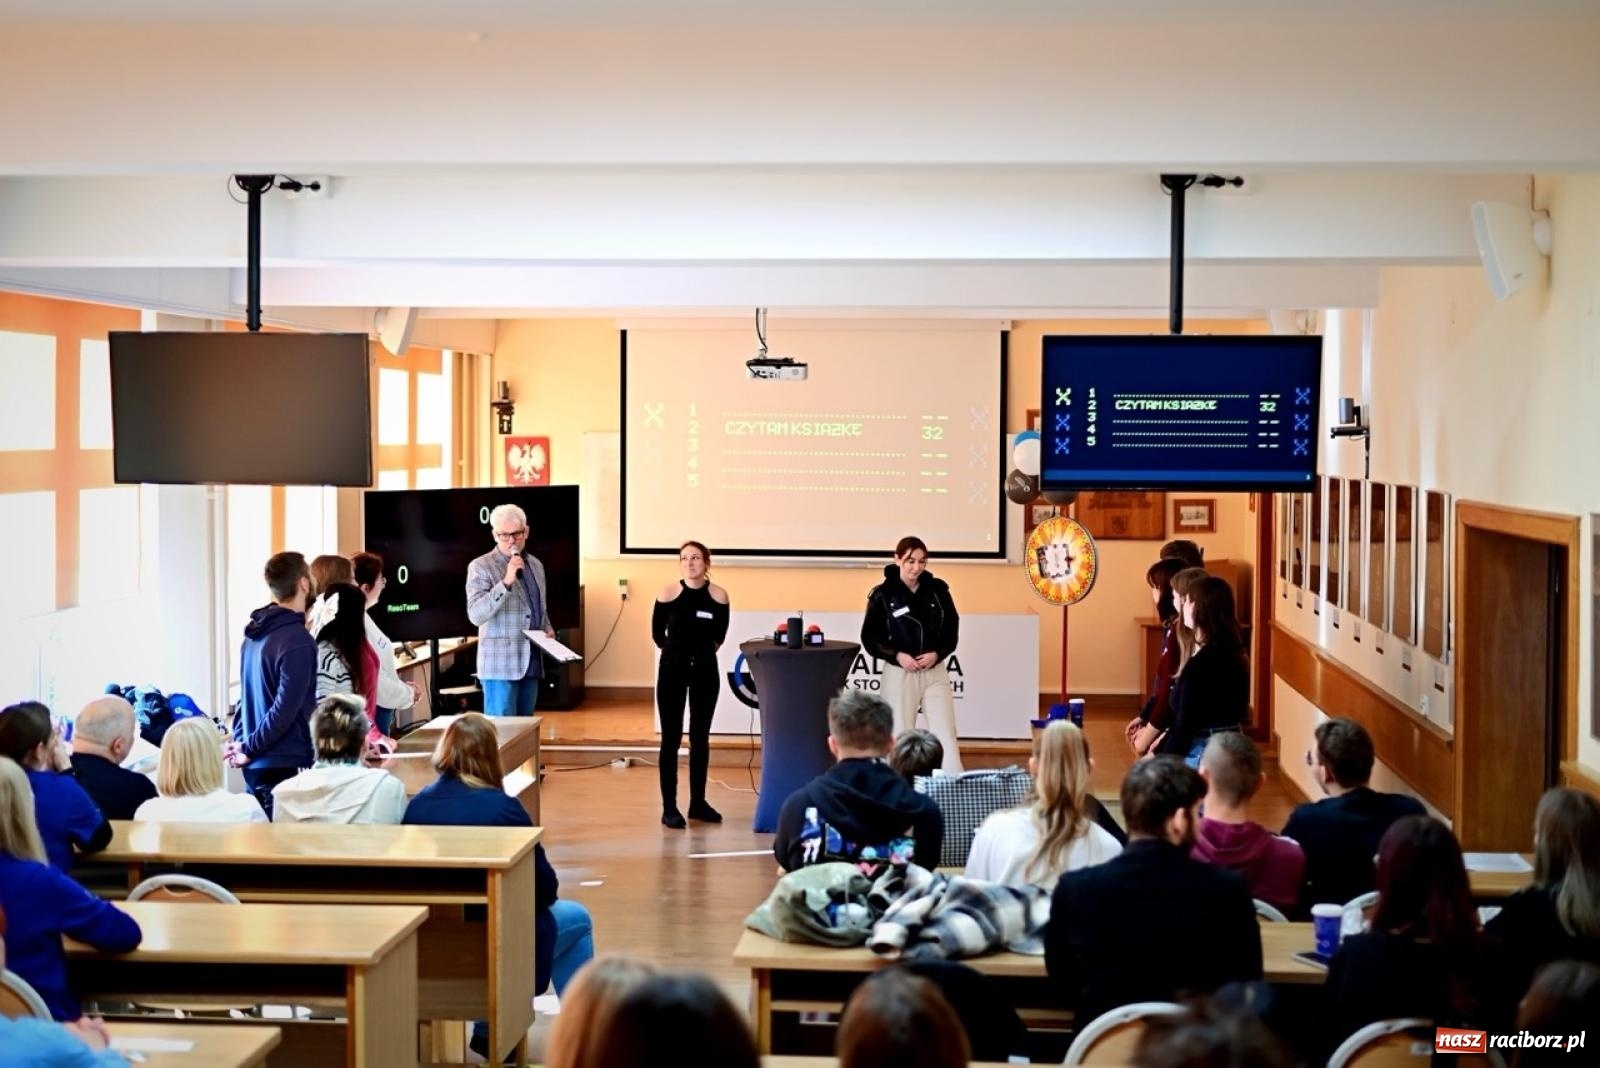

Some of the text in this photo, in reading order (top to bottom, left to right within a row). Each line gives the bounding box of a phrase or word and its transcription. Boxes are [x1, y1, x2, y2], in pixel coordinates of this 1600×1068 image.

[1089, 387, 1096, 398] 1
[1087, 399, 1097, 410] 2
[1115, 399, 1162, 411] CZYTAM
[1259, 401, 1277, 412] 32
[1087, 411, 1097, 422] 3
[686, 419, 699, 435] 2
[724, 420, 789, 436] CZYTAM
[921, 425, 944, 440] 32
[1086, 423, 1096, 434] 4
[686, 437, 699, 453] 3
[1086, 435, 1096, 446] 5
[686, 472, 699, 488] 5
[397, 565, 409, 584] 0
